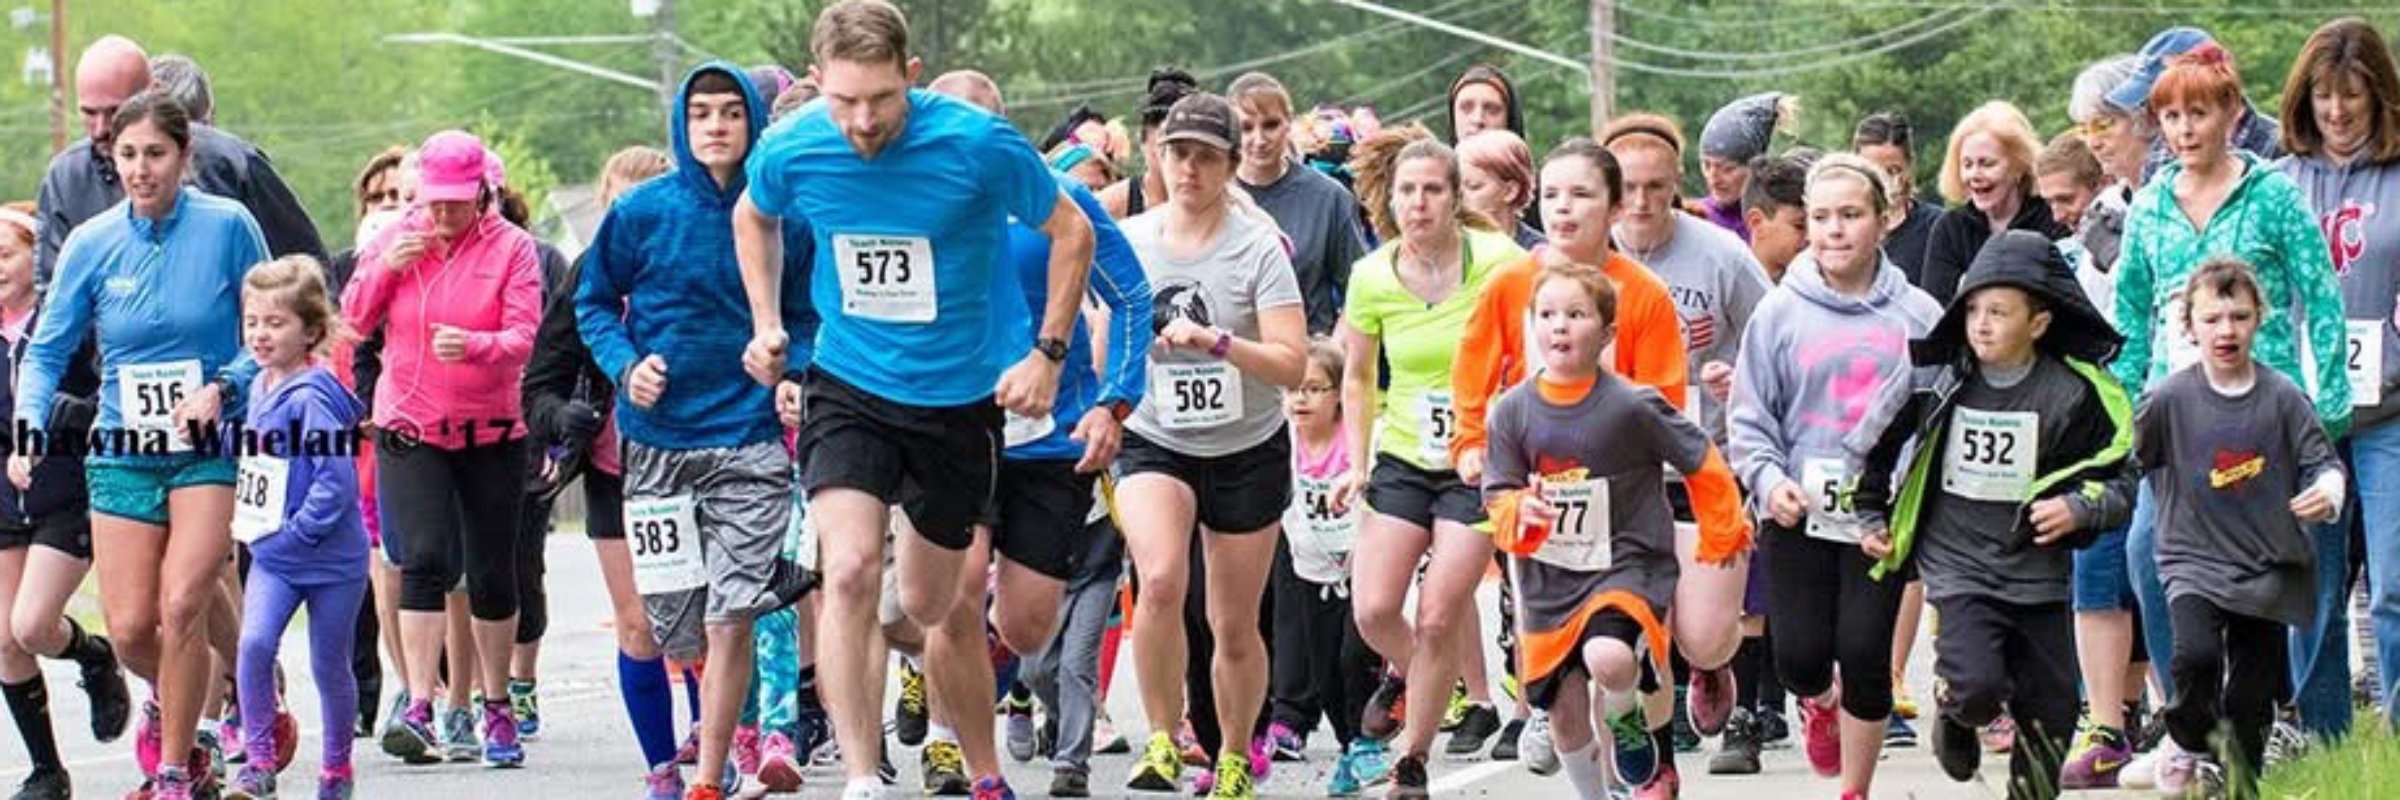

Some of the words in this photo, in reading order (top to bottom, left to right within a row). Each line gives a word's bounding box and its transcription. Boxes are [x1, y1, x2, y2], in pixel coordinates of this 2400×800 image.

[856, 250, 911, 285] 573
[1174, 378, 1224, 412] 582
[1963, 428, 2015, 465] 532
[1305, 491, 1345, 521] 54
[1546, 500, 1589, 534] 77
[633, 519, 680, 556] 583
